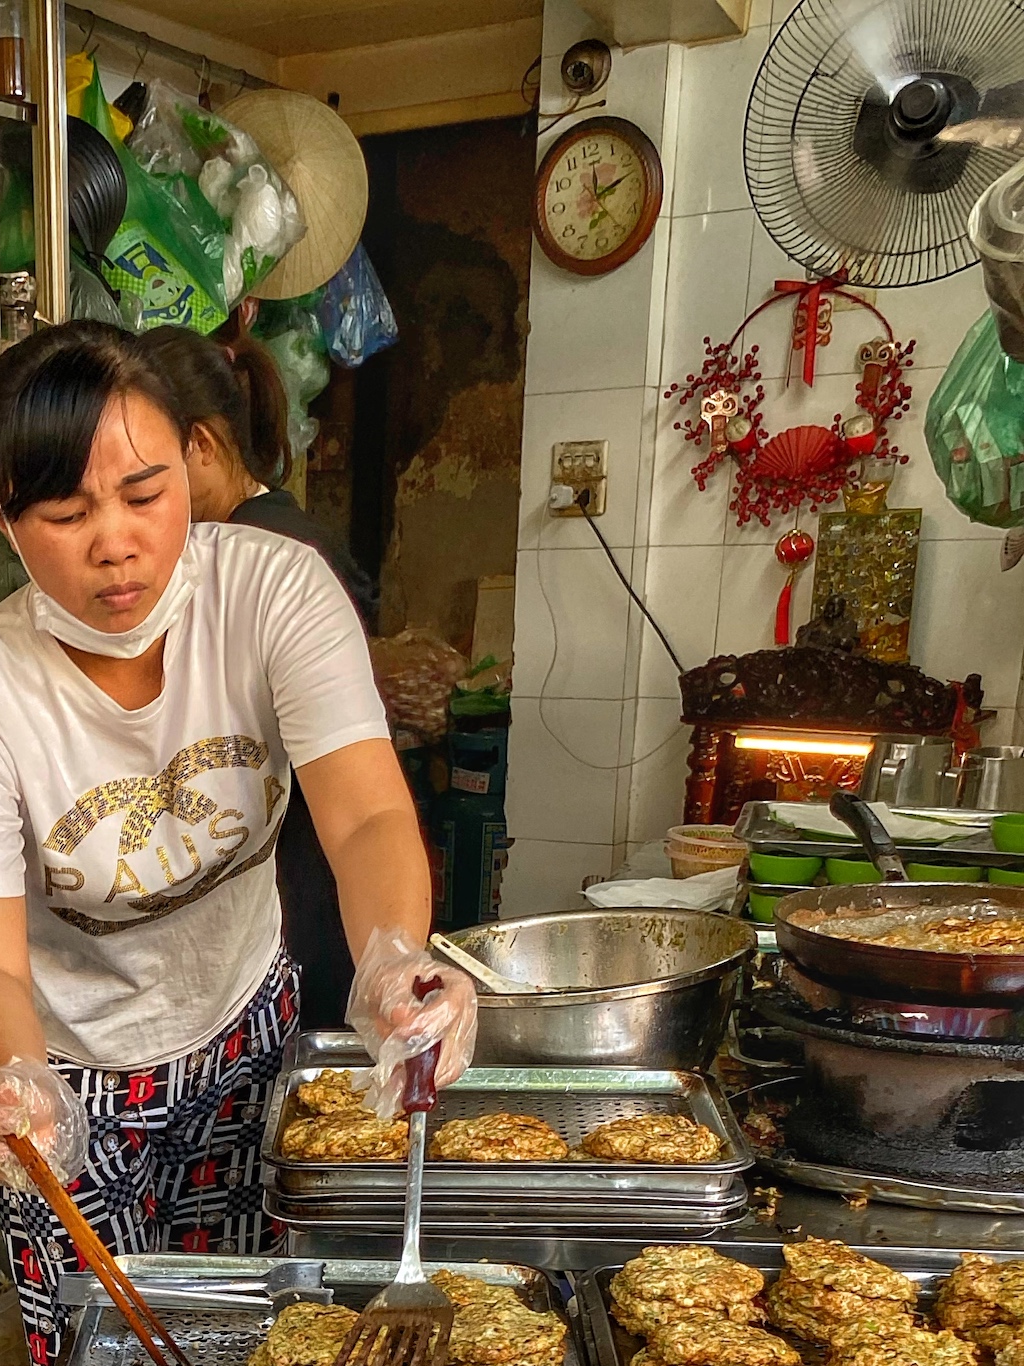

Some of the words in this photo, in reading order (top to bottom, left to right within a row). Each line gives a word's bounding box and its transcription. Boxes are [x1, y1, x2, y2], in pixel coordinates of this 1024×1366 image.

[582, 143, 599, 159] 12
[567, 157, 578, 172] 11
[555, 177, 572, 193] 10
[562, 224, 576, 238] 8
[577, 234, 589, 249] 7
